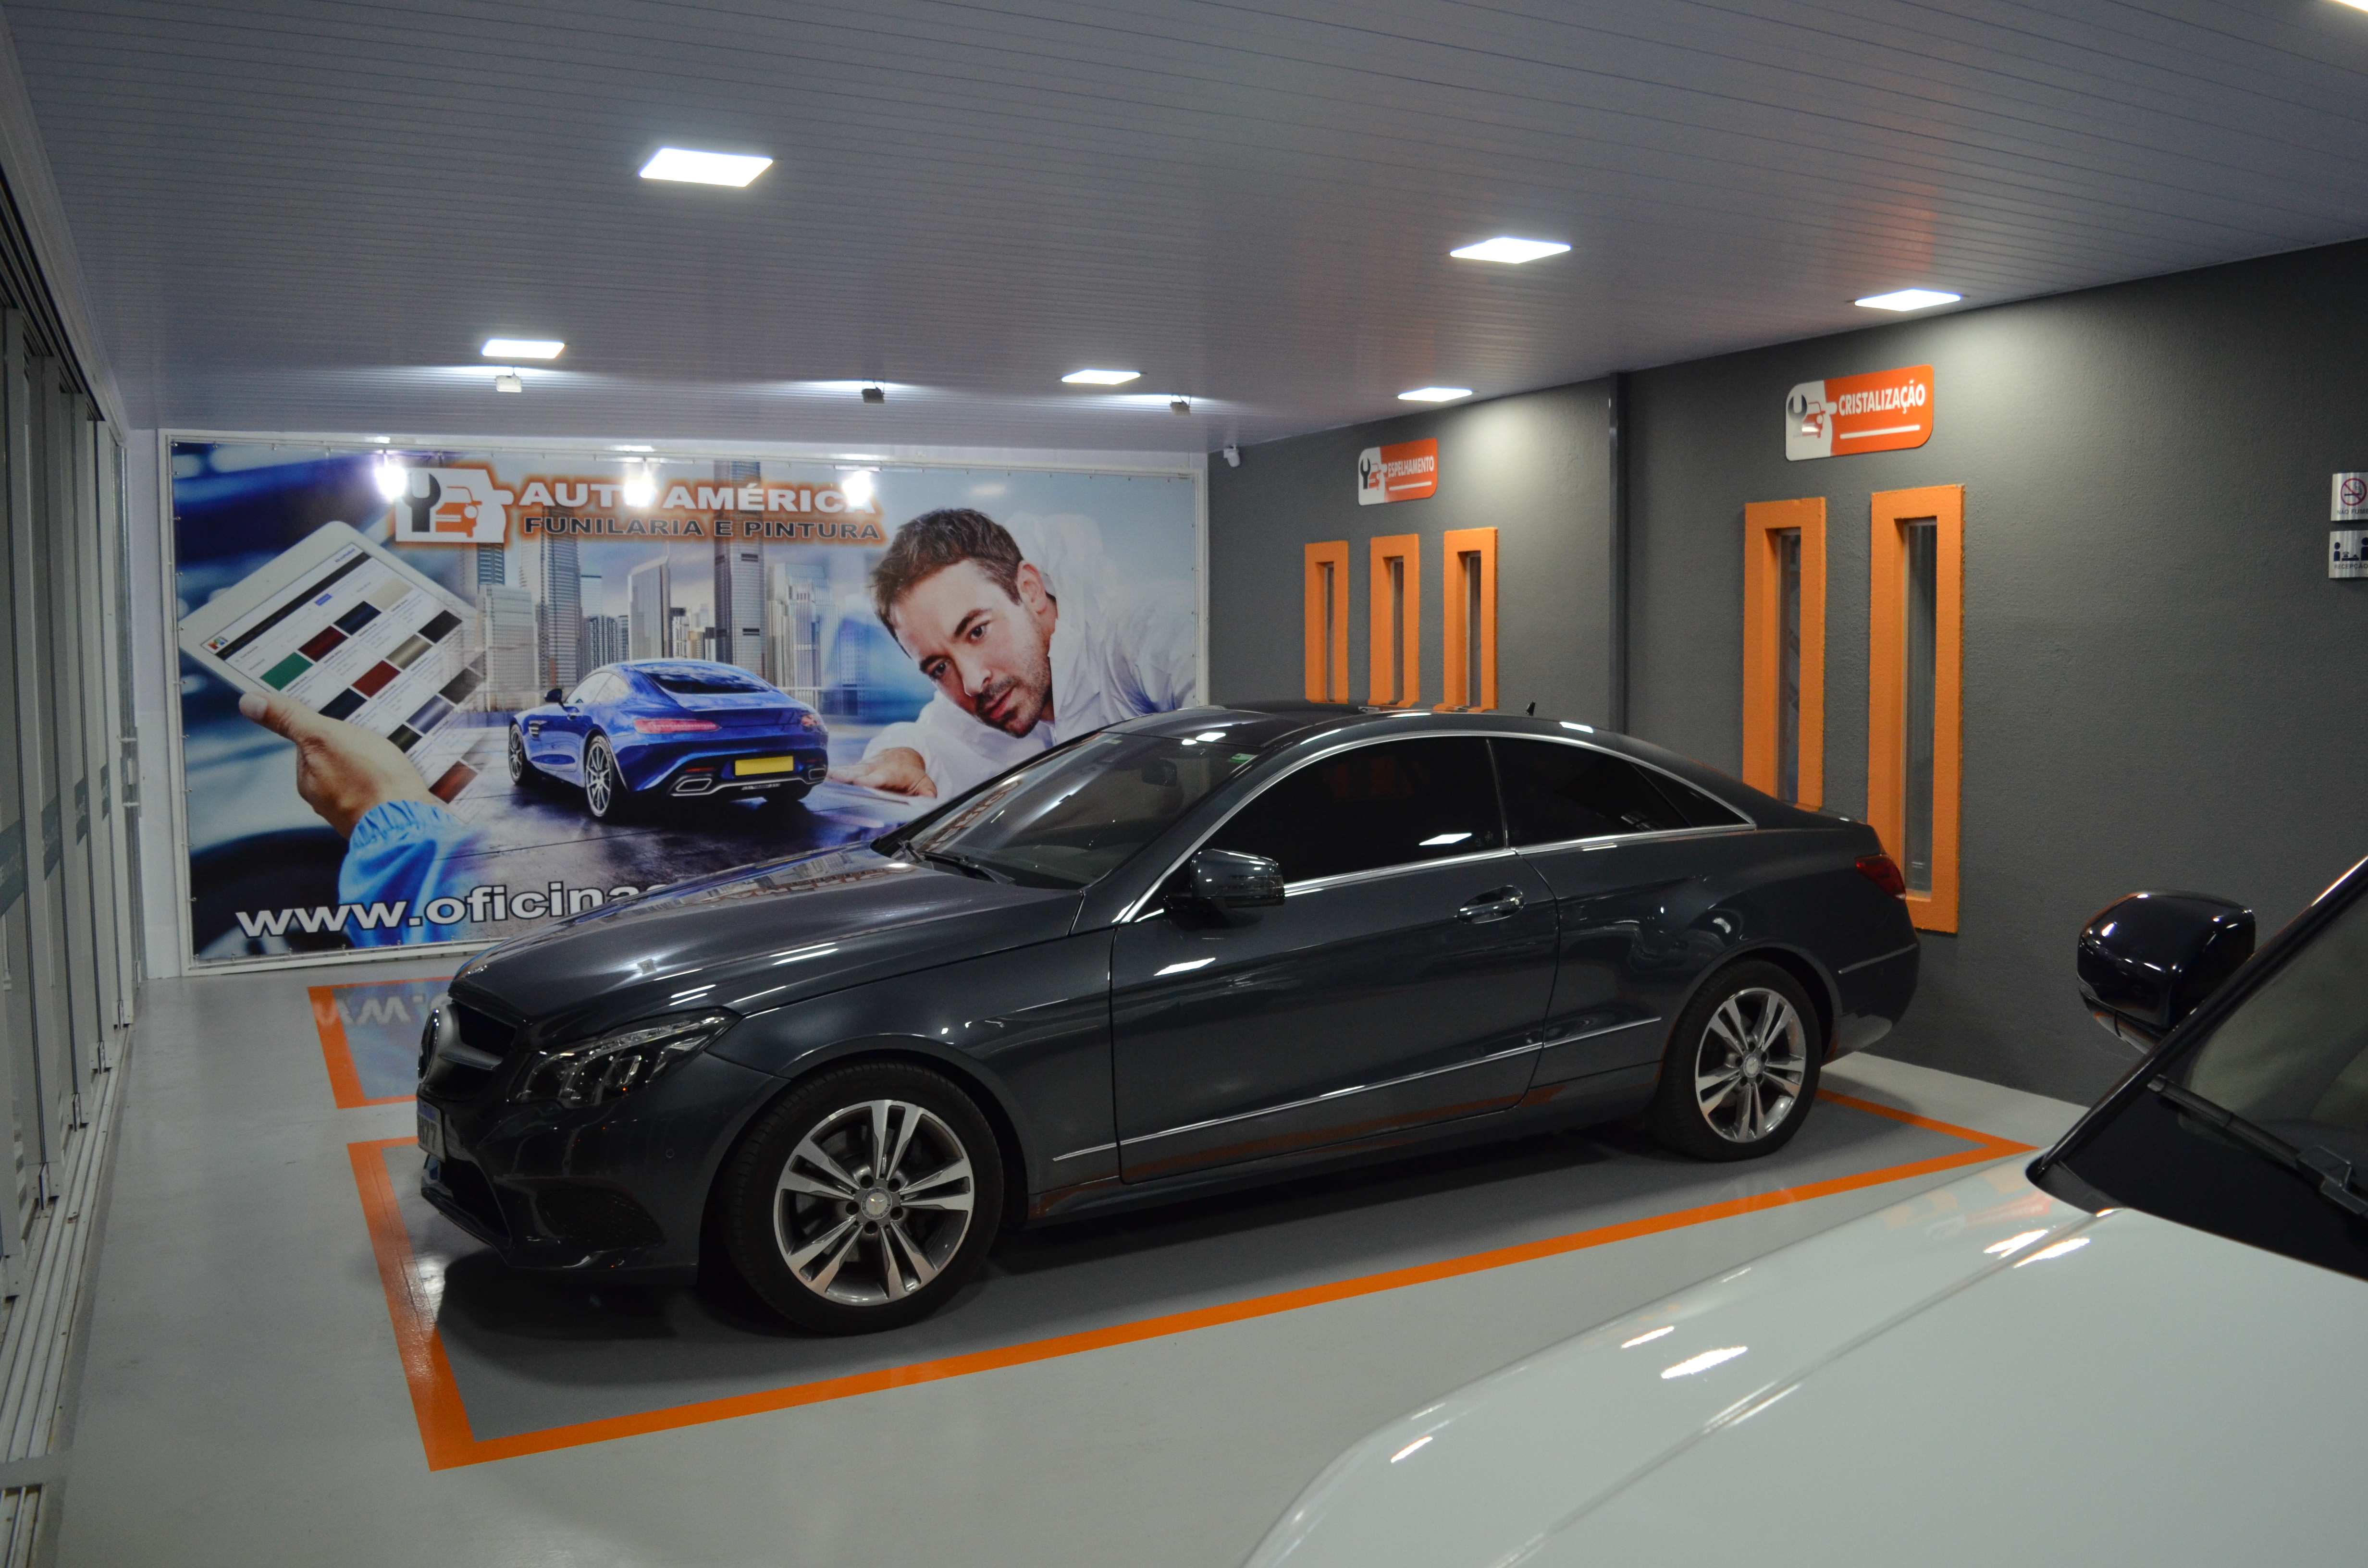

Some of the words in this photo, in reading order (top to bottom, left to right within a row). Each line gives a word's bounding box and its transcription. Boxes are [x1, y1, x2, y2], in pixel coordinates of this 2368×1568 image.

[1838, 380, 1925, 416] CRISTALIZAÇÃO
[1388, 455, 1434, 478] ESPELHAMENTO
[524, 516, 703, 537] FUNILARIA
[714, 520, 733, 537] E
[743, 520, 880, 540] PINTURA
[235, 881, 668, 939] www.oficin
